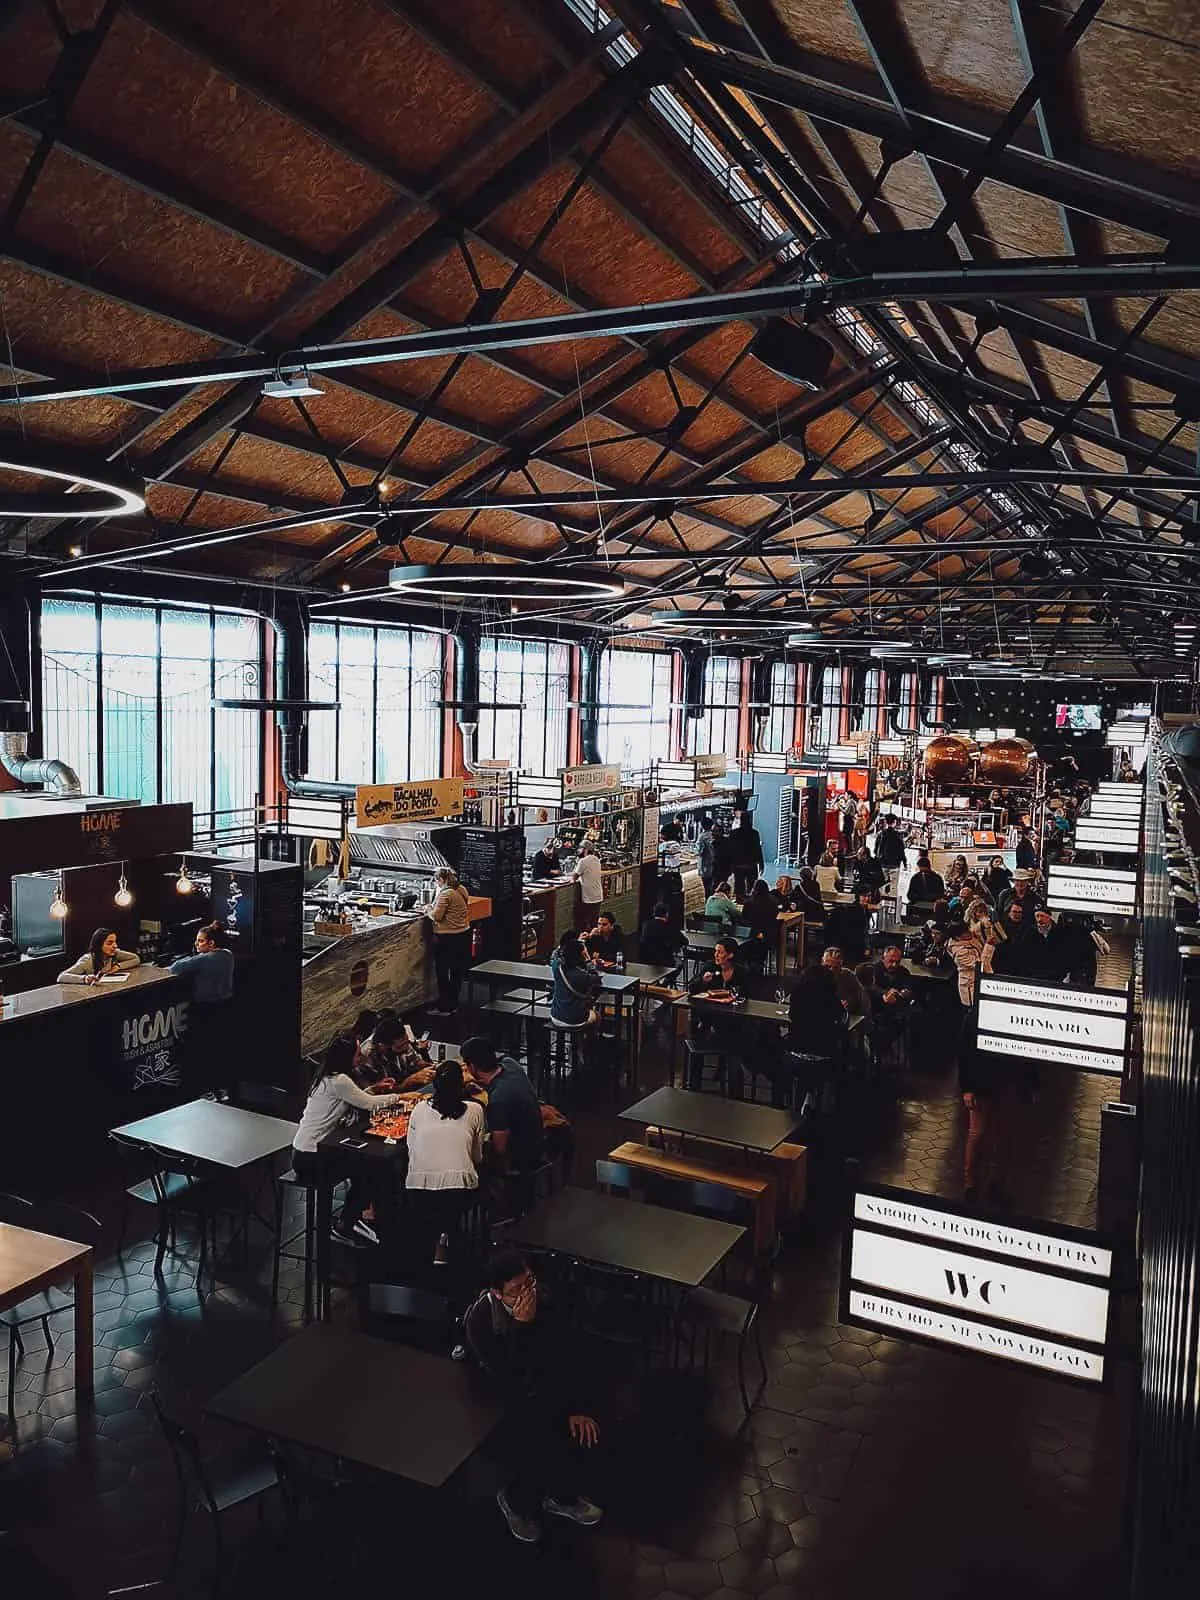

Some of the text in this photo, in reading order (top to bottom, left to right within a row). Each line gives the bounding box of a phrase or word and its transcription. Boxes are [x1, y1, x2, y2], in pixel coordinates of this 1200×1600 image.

[393, 788, 433, 801] BACALHAU
[396, 801, 409, 811] DO
[80, 813, 121, 832] HOME
[121, 1002, 189, 1051] HOME
[1010, 1015, 1091, 1036] DRINKARIA
[866, 1202, 1098, 1266] SABORES TRADIÇÃO CULTURA
[943, 1268, 1010, 1305] WC
[950, 1323, 985, 1342] VILA
[987, 1333, 1025, 1353] NOVA
[1028, 1344, 1049, 1359] DE
[1052, 1350, 1091, 1370] GAIA
